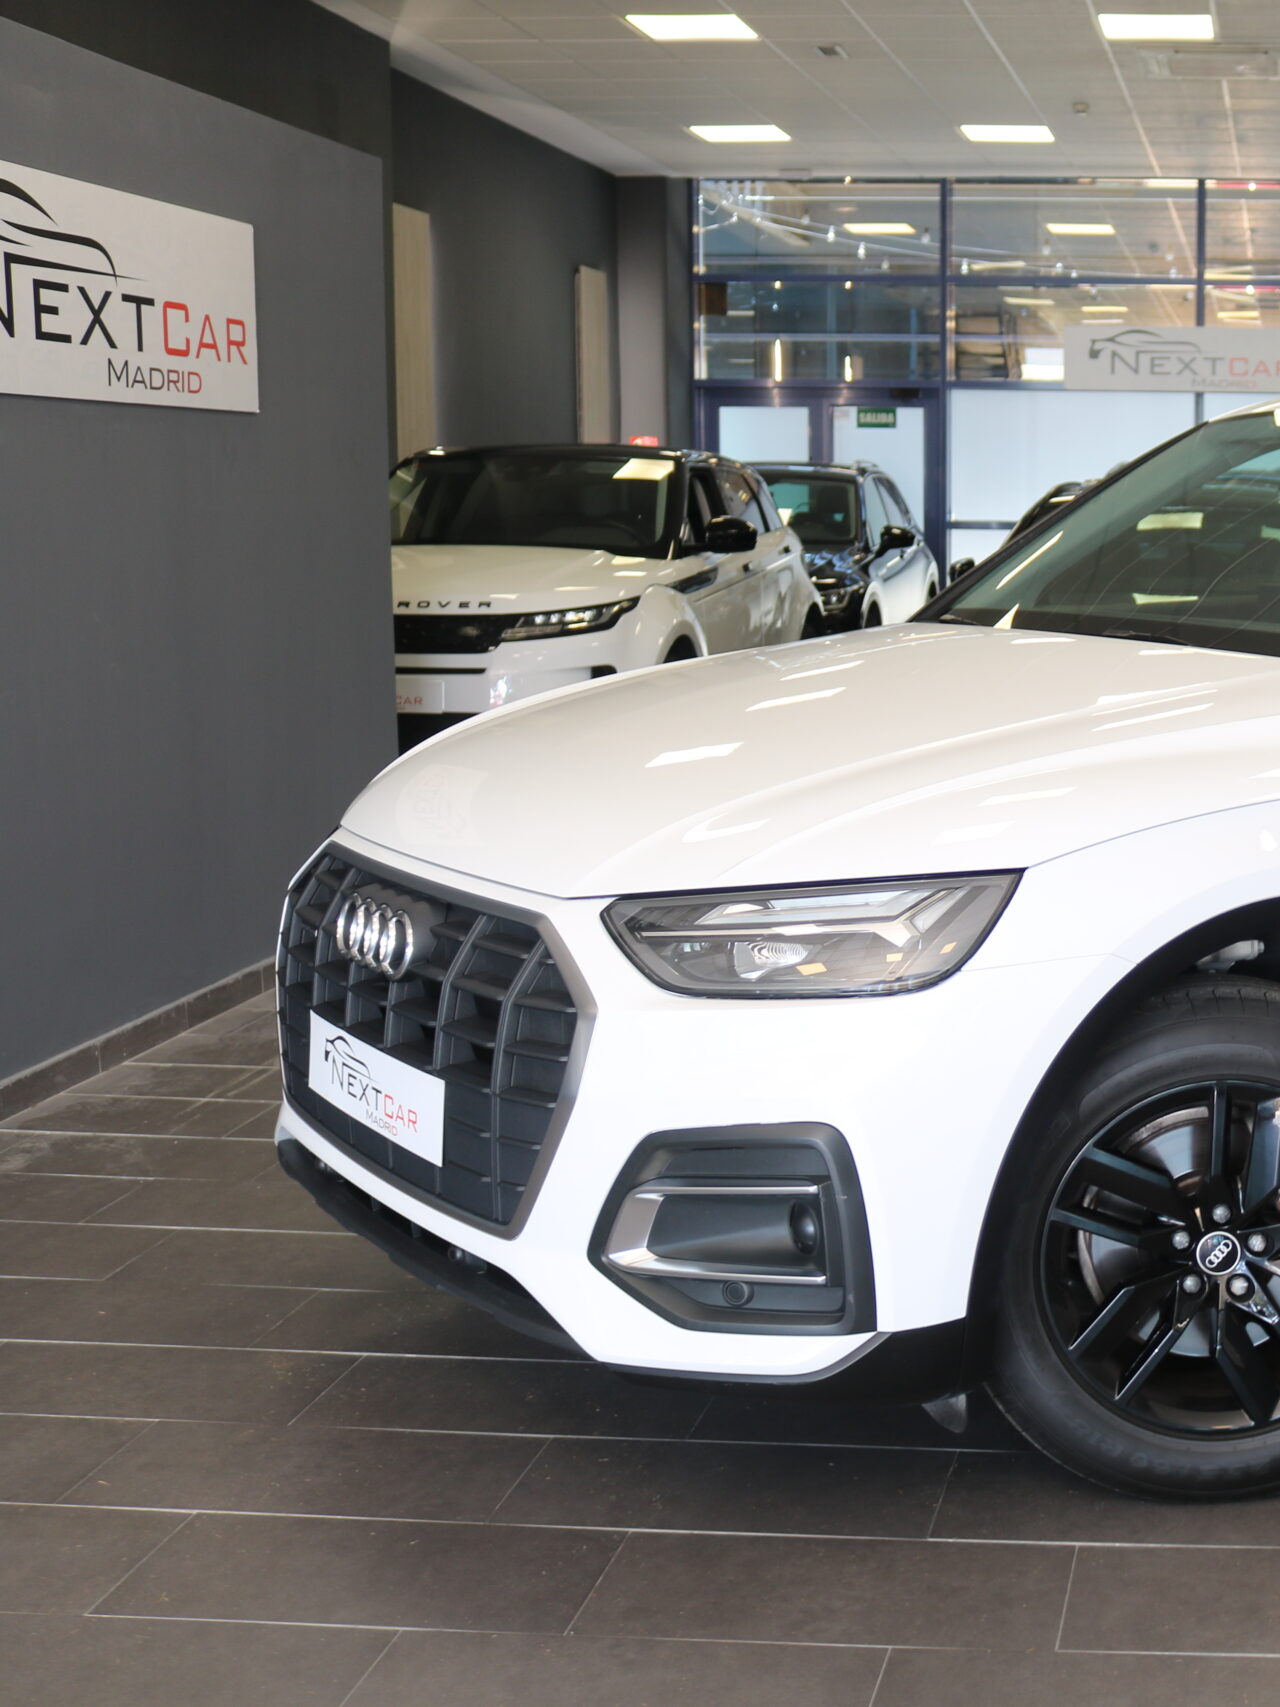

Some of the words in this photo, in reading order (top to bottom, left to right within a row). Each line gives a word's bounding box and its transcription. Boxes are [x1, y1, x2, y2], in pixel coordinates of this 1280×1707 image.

[107, 357, 203, 394] MADRID
[860, 412, 895, 423] SALIDA
[331, 1055, 418, 1132] NEXTCAR
[366, 1109, 398, 1137] MADRID
